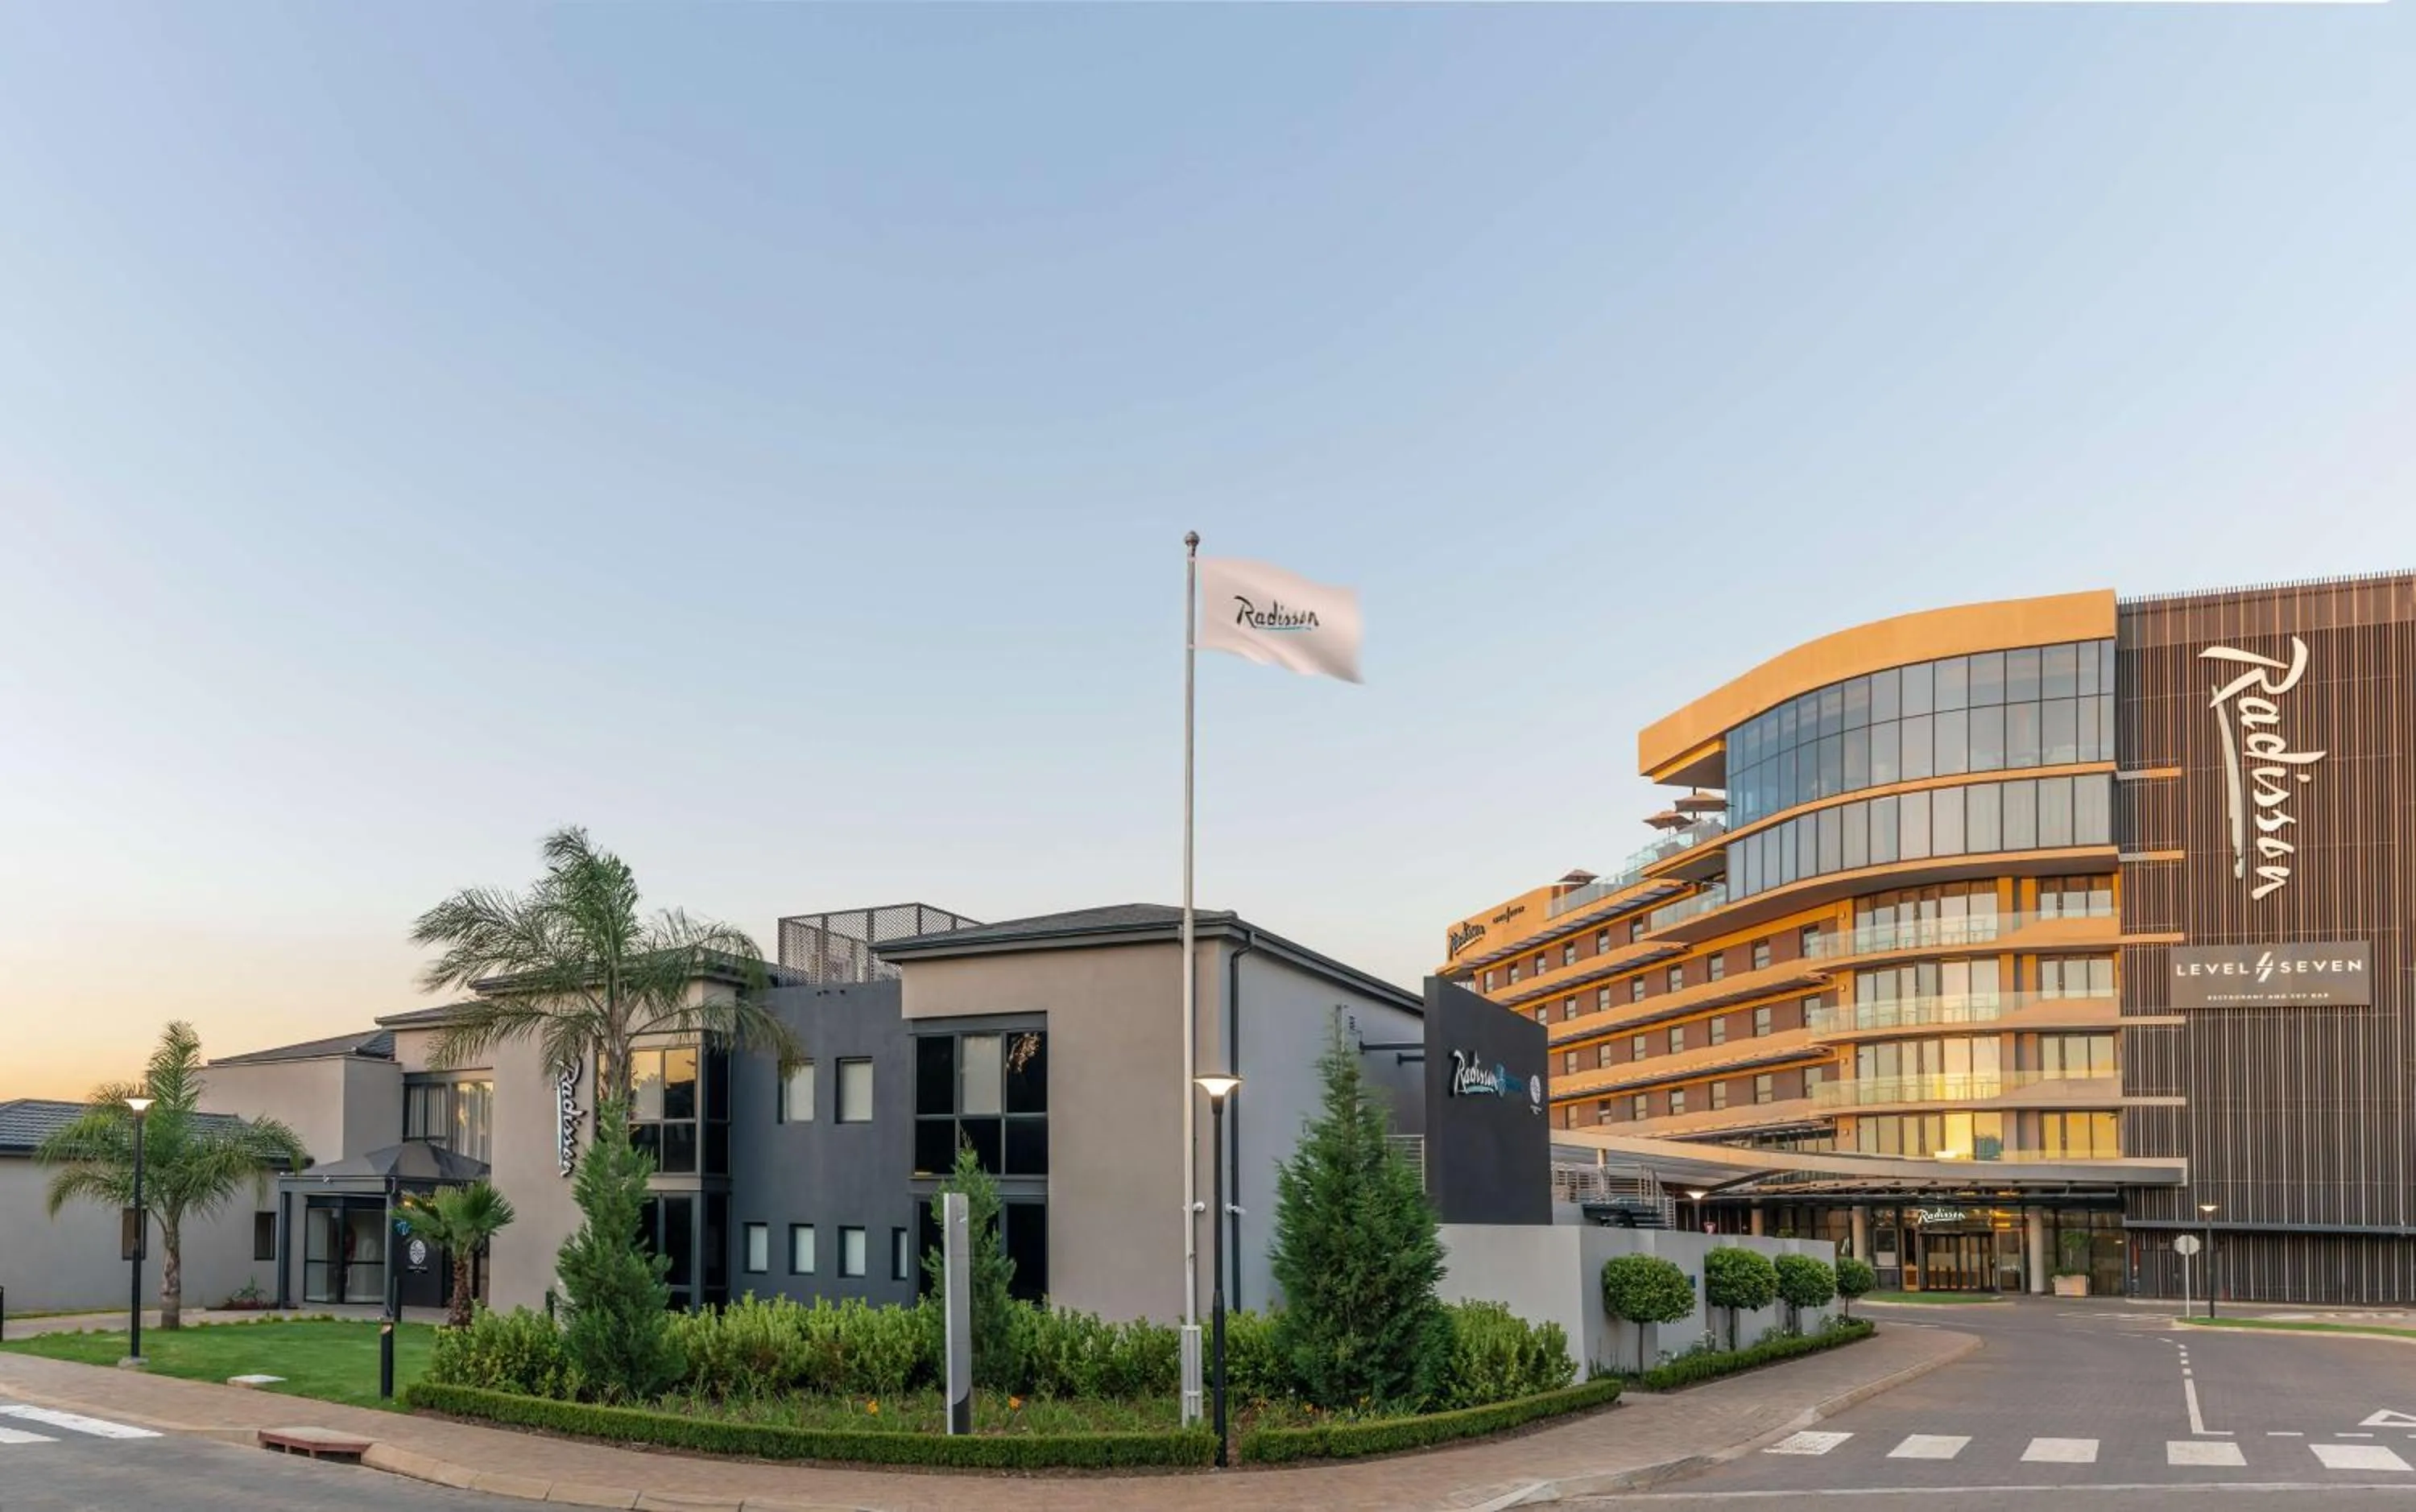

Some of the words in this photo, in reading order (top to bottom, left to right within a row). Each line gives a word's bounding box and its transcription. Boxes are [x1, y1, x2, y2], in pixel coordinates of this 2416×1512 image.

[1234, 594, 1320, 630] Radisson
[2198, 635, 2327, 900] Radisson
[2177, 963, 2249, 977] LEVEL
[2280, 959, 2363, 973] SEVEN
[1453, 1049, 1499, 1096] Radisson
[555, 1056, 585, 1177] Radisson
[1917, 1208, 1966, 1224] Radisson
